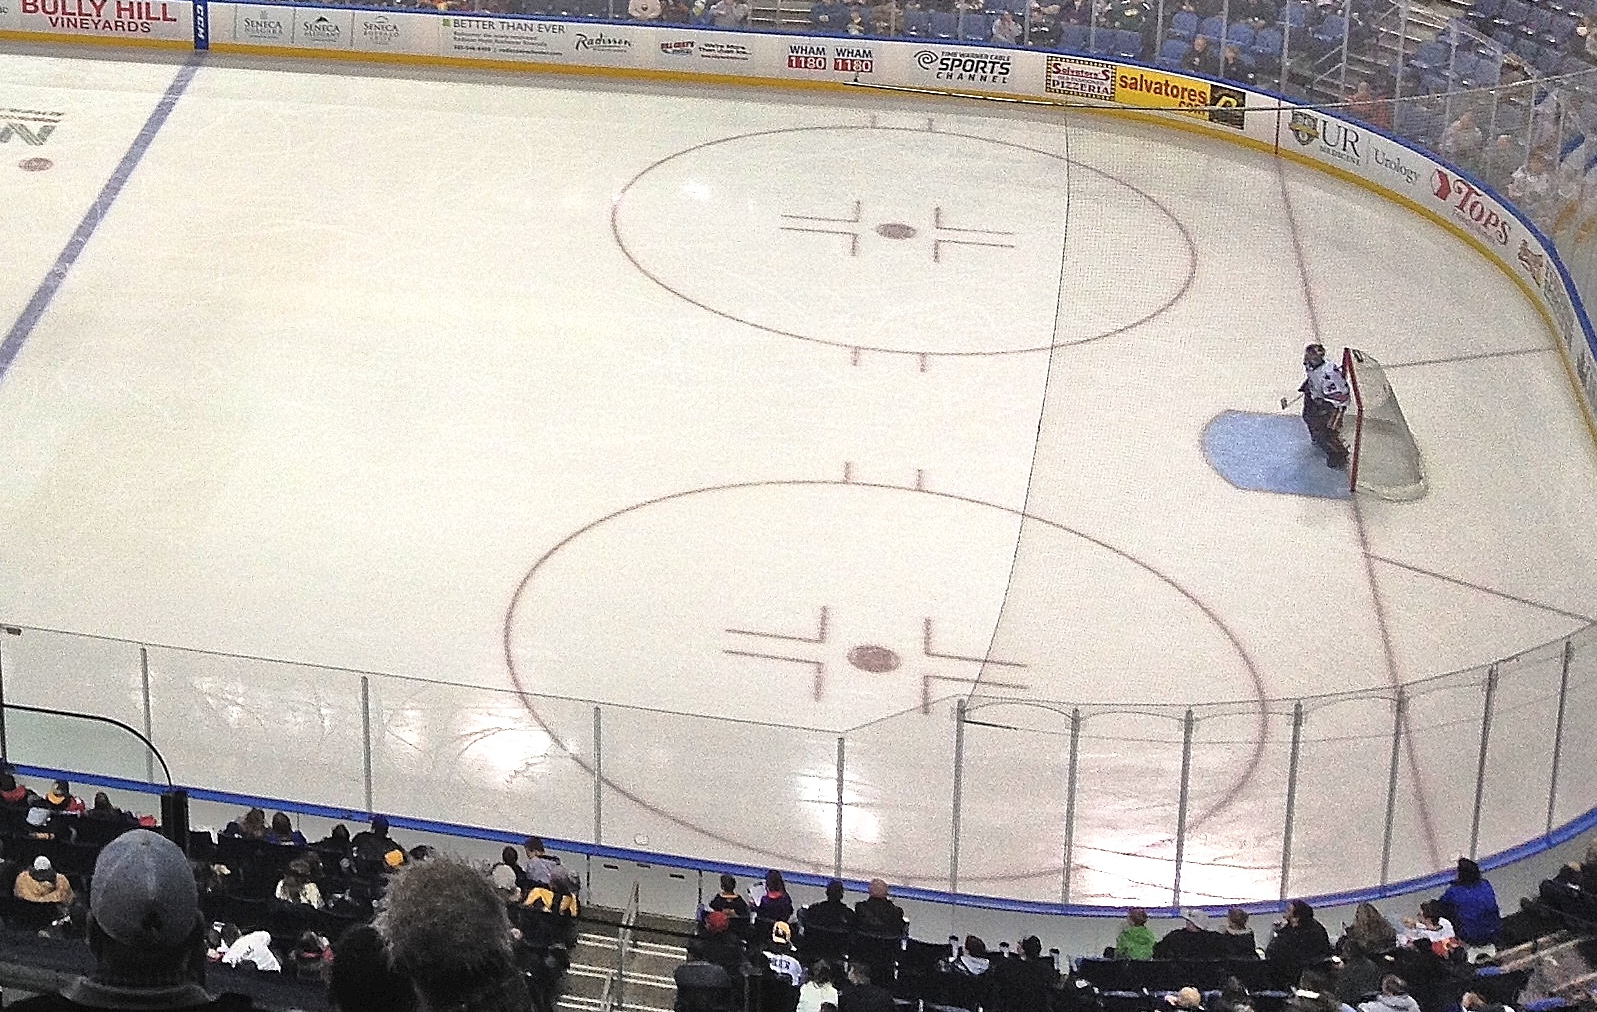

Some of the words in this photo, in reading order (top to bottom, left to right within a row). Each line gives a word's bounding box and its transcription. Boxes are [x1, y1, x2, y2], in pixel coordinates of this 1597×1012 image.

[116, 0, 178, 23] HILL
[48, 15, 151, 34] VINEYARDS
[196, 3, 205, 41] CCM
[244, 17, 283, 29] SENECA
[303, 21, 341, 33] SENECA
[363, 21, 399, 32] SENECA
[453, 18, 496, 31] BETTER
[499, 21, 534, 32] THAN
[537, 23, 566, 34] EVER
[575, 32, 632, 51] Radisson
[789, 44, 826, 56] WHAM
[835, 47, 873, 59] WHAM
[789, 56, 826, 69] 1180
[835, 59, 872, 72] 1180
[938, 57, 1012, 77] SPORTS
[936, 71, 1008, 84] CHANNEL
[1051, 79, 1110, 95] PIZZERIA
[1119, 73, 1207, 104] salvatores
[1321, 119, 1360, 158] UR
[1373, 146, 1421, 185] Urology
